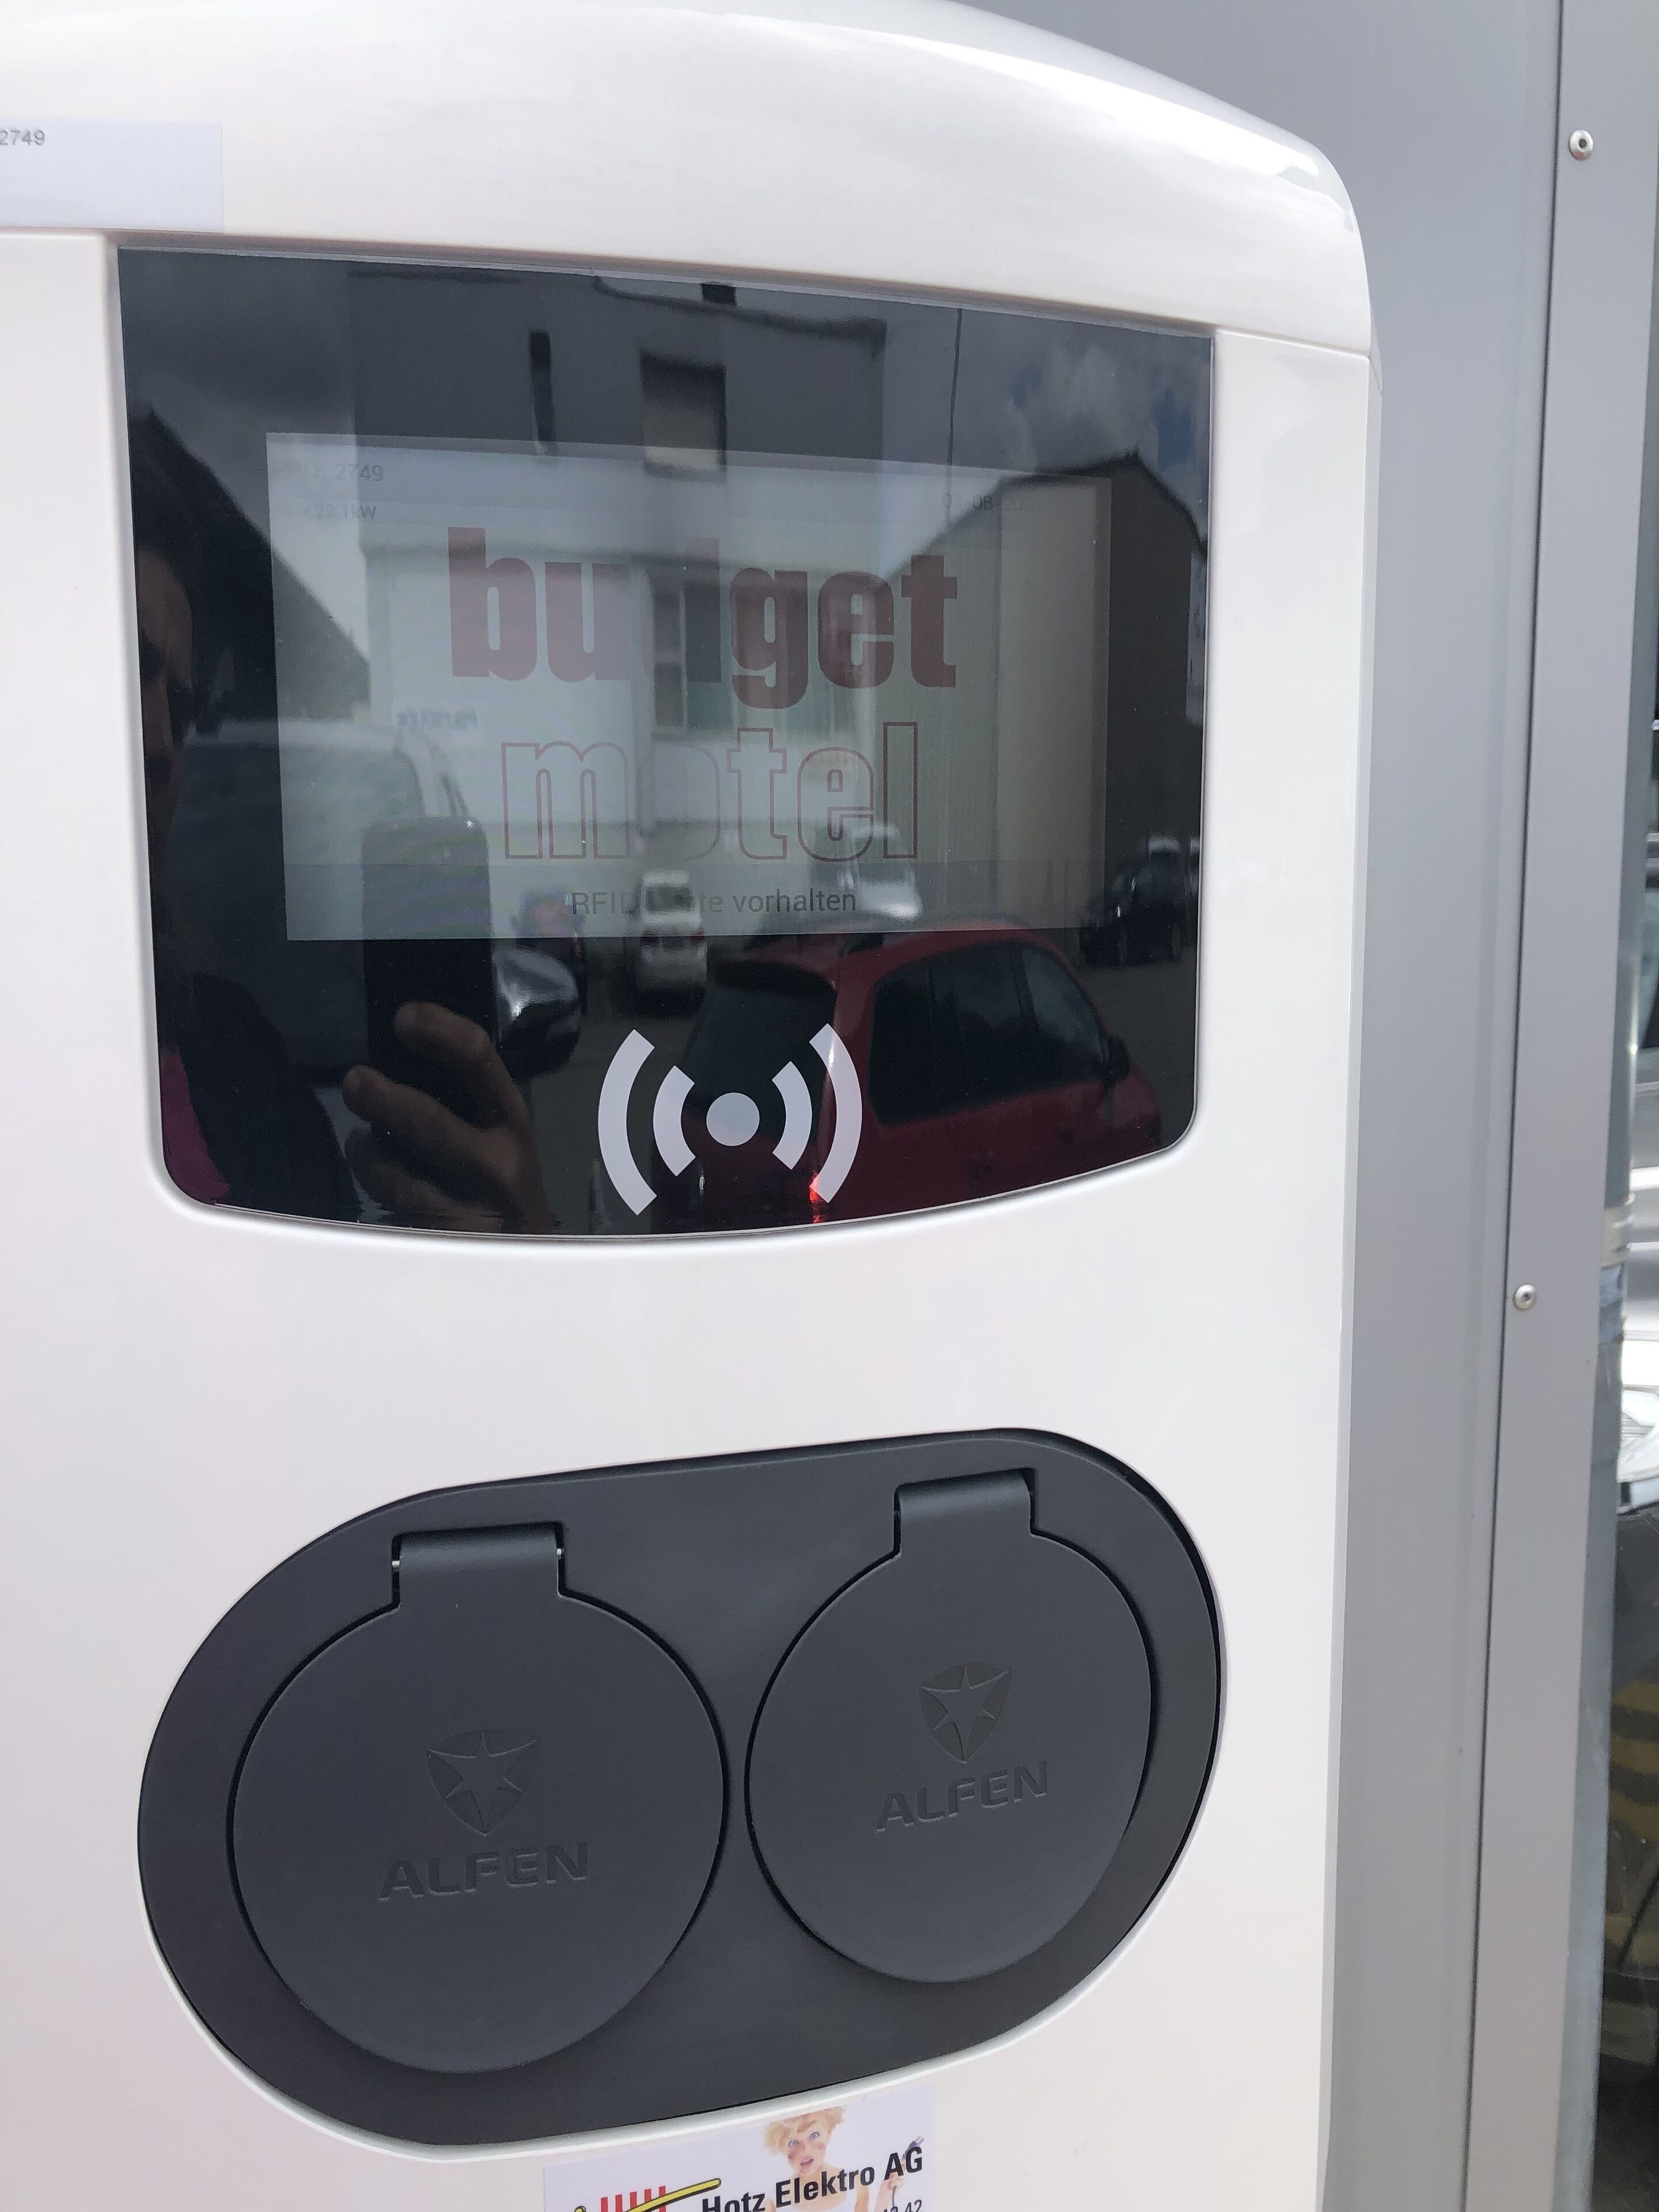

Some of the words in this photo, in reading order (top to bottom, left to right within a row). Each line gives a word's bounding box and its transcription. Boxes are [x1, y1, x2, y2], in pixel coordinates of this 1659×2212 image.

[0, 130, 45, 146] 2749
[501, 722, 918, 862] motel
[733, 888, 857, 913] vorhalten
[876, 1760, 1048, 1833] ALFEN
[378, 1841, 589, 1902] ALFEN
[702, 2192, 765, 2212] Hotz
[775, 2166, 875, 2207] Elektro
[884, 2146, 923, 2180] AG
